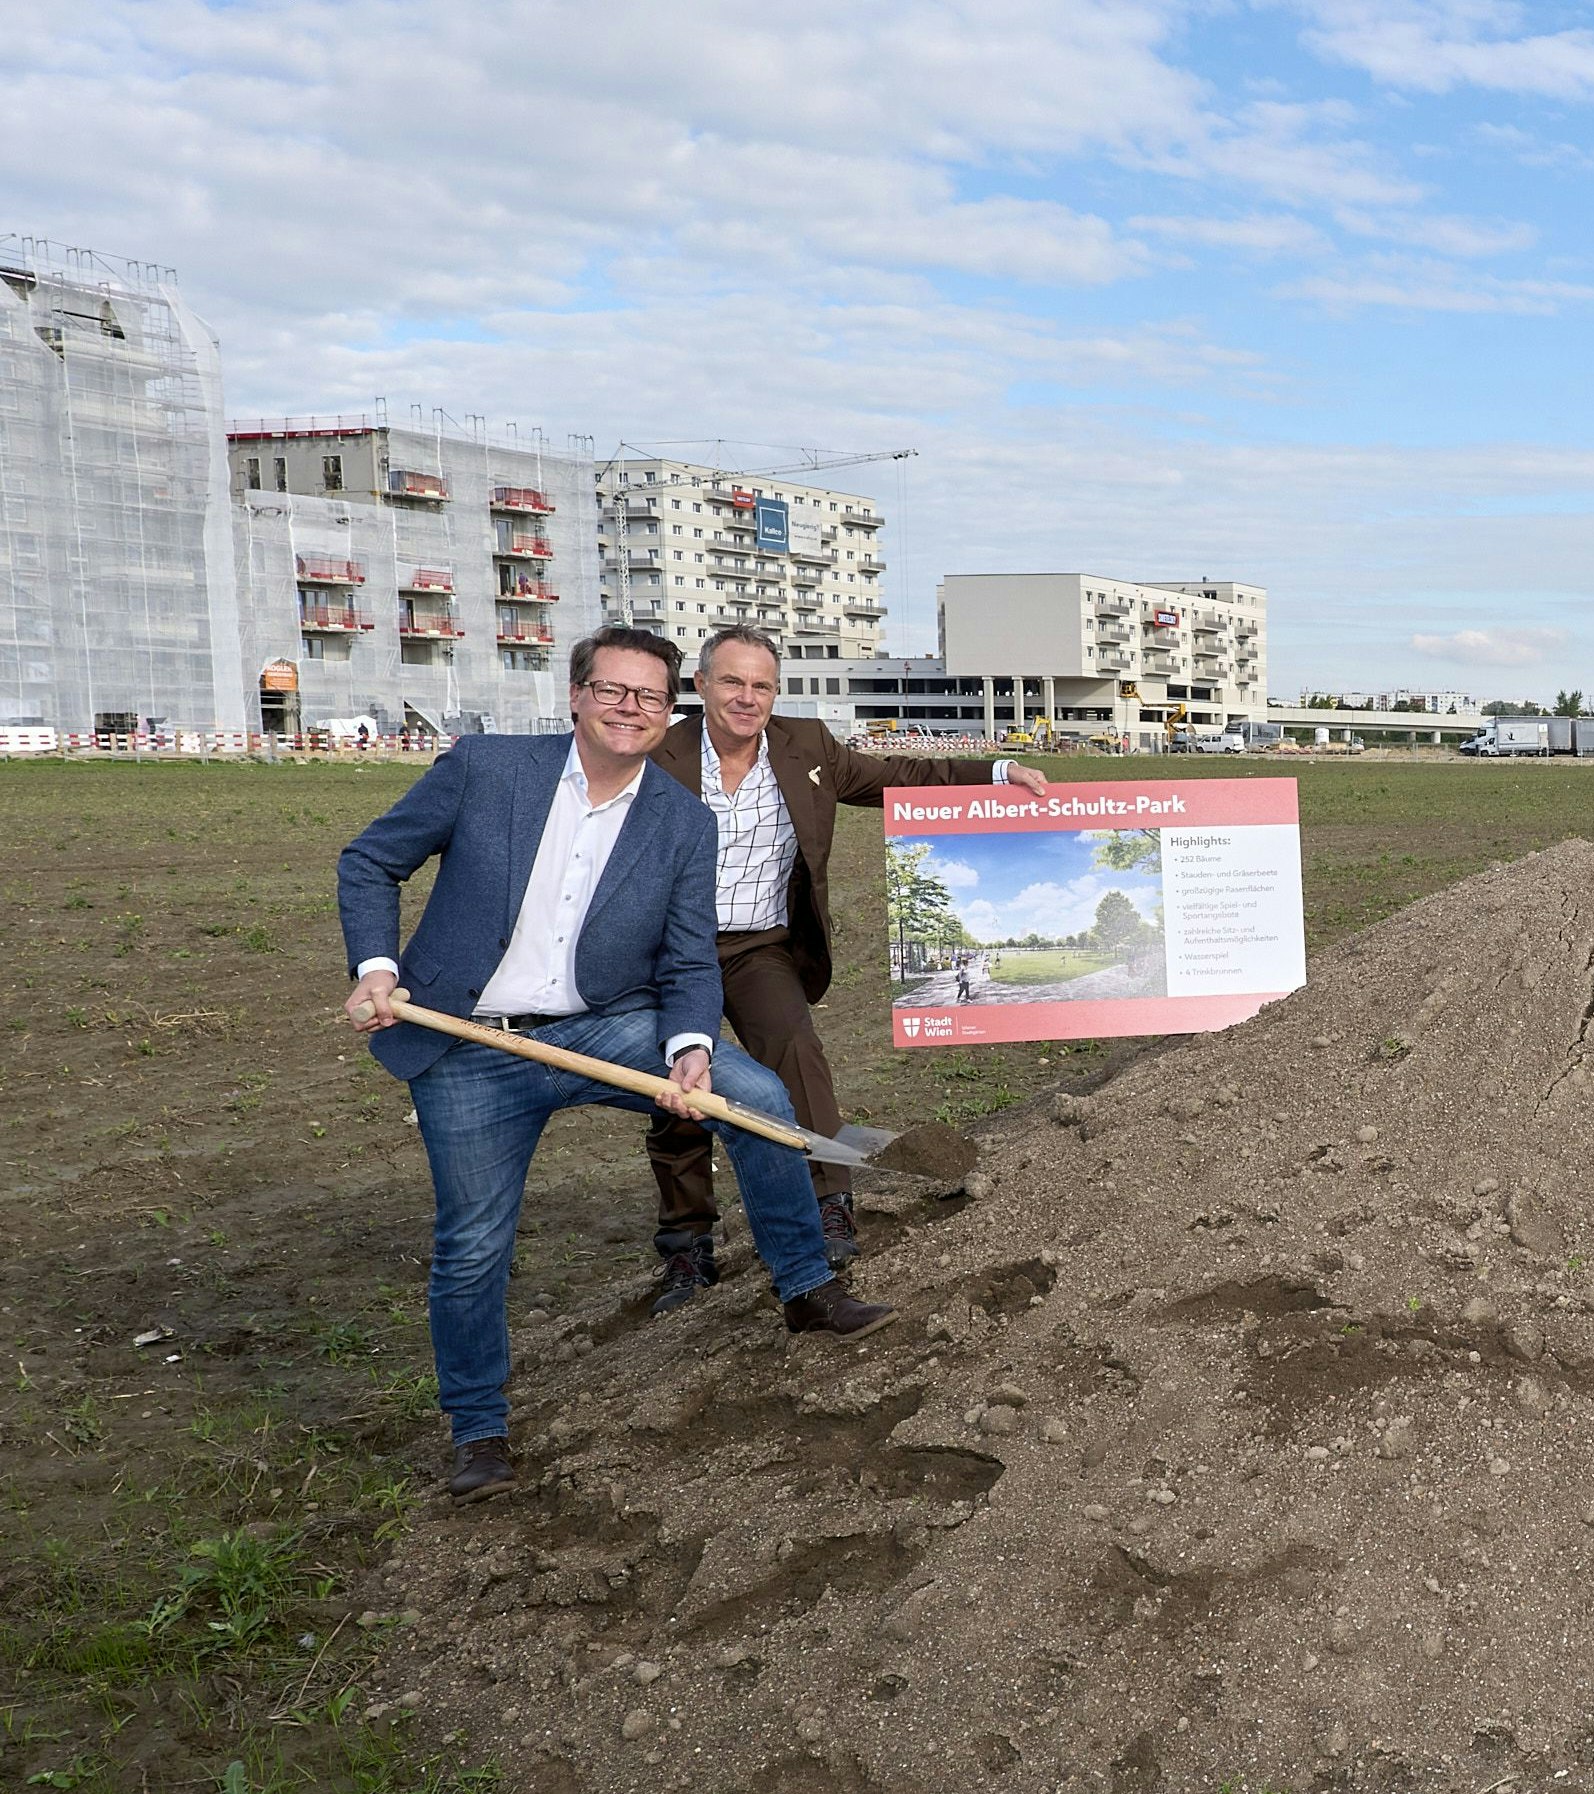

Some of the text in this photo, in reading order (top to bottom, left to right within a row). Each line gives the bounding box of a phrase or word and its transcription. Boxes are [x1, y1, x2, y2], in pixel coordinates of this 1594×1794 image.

[893, 795, 1186, 821] Neuer Albert-Schultz-Park
[1170, 836, 1231, 848] Highlights:
[1196, 855, 1222, 863] Bäume
[1181, 869, 1278, 879] Stauden- und Gräserbeete
[1181, 885, 1274, 896] großzügige Rasenflächen
[1242, 900, 1257, 908] und
[1183, 911, 1239, 920] Sportangebote
[1183, 927, 1221, 935] zahlreiche
[1183, 935, 1279, 945] Aufenthaltsmöglichkeiten
[1184, 952, 1229, 961] Wasserspiel
[1192, 967, 1242, 976] Trinkbrunnen
[924, 1016, 952, 1027] Stadt
[924, 1027, 953, 1037] Wien
